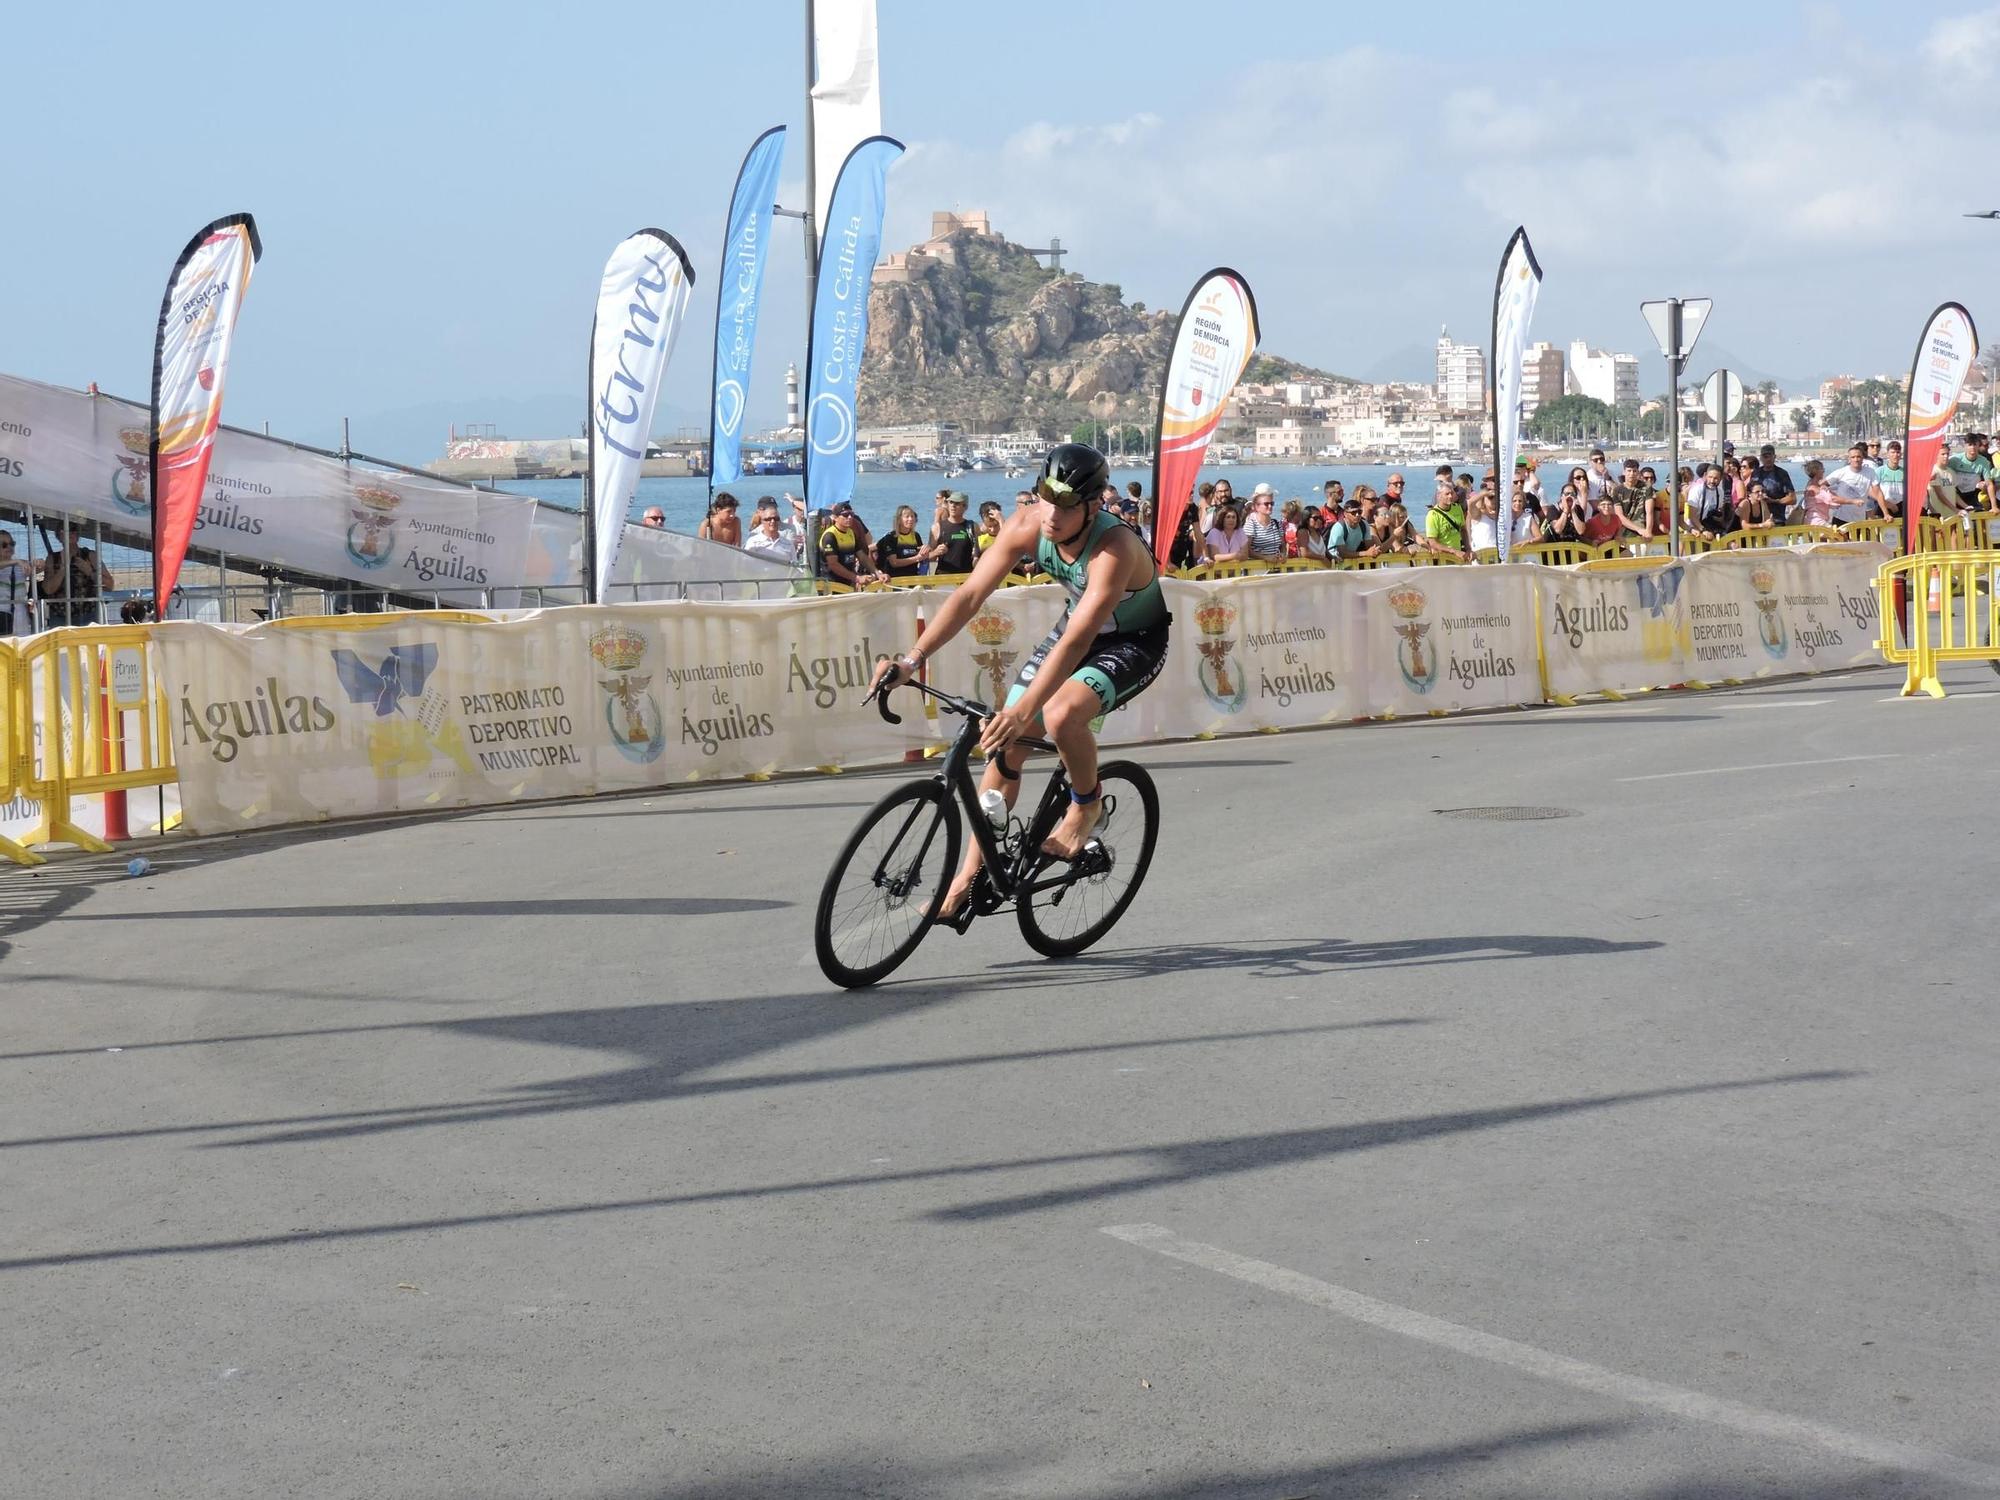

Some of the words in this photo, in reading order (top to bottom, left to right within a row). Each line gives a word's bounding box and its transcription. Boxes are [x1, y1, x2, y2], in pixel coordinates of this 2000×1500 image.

[834, 215, 861, 301] Cálida
[1195, 317, 1222, 332] REGIÓN
[825, 310, 847, 383] Costa
[1192, 341, 1216, 361] 2023
[1203, 331, 1230, 347] MURCIA
[206, 473, 272, 495] ntamiento
[215, 489, 231, 504] de
[408, 519, 496, 545] Ayuntamiento
[442, 540, 458, 554] de
[403, 545, 488, 584] Águilas
[1553, 592, 1630, 649] Águilas
[1691, 603, 1740, 619] PATRONATO
[1836, 585, 1879, 630] Águil
[1441, 613, 1511, 631] Ayuntamiento
[1694, 623, 1743, 641] DEPORTIVO
[1246, 626, 1326, 650] Ayuntamiento
[1472, 632, 1485, 649] de
[1795, 622, 1843, 657] Águilas
[1284, 648, 1298, 665] de
[1697, 643, 1747, 662] MUNICIPAL
[665, 659, 765, 693] Ayuntamiento
[786, 636, 905, 709] Águil
[1449, 649, 1516, 690] Águilas
[712, 685, 730, 705] de
[1260, 662, 1336, 707] Águilas
[460, 685, 565, 715] PATRONATO
[181, 676, 336, 763] Águilas
[468, 715, 572, 745] DEPORTIVO
[681, 703, 775, 756] Águilas
[478, 744, 582, 772] MUNICIPAL
